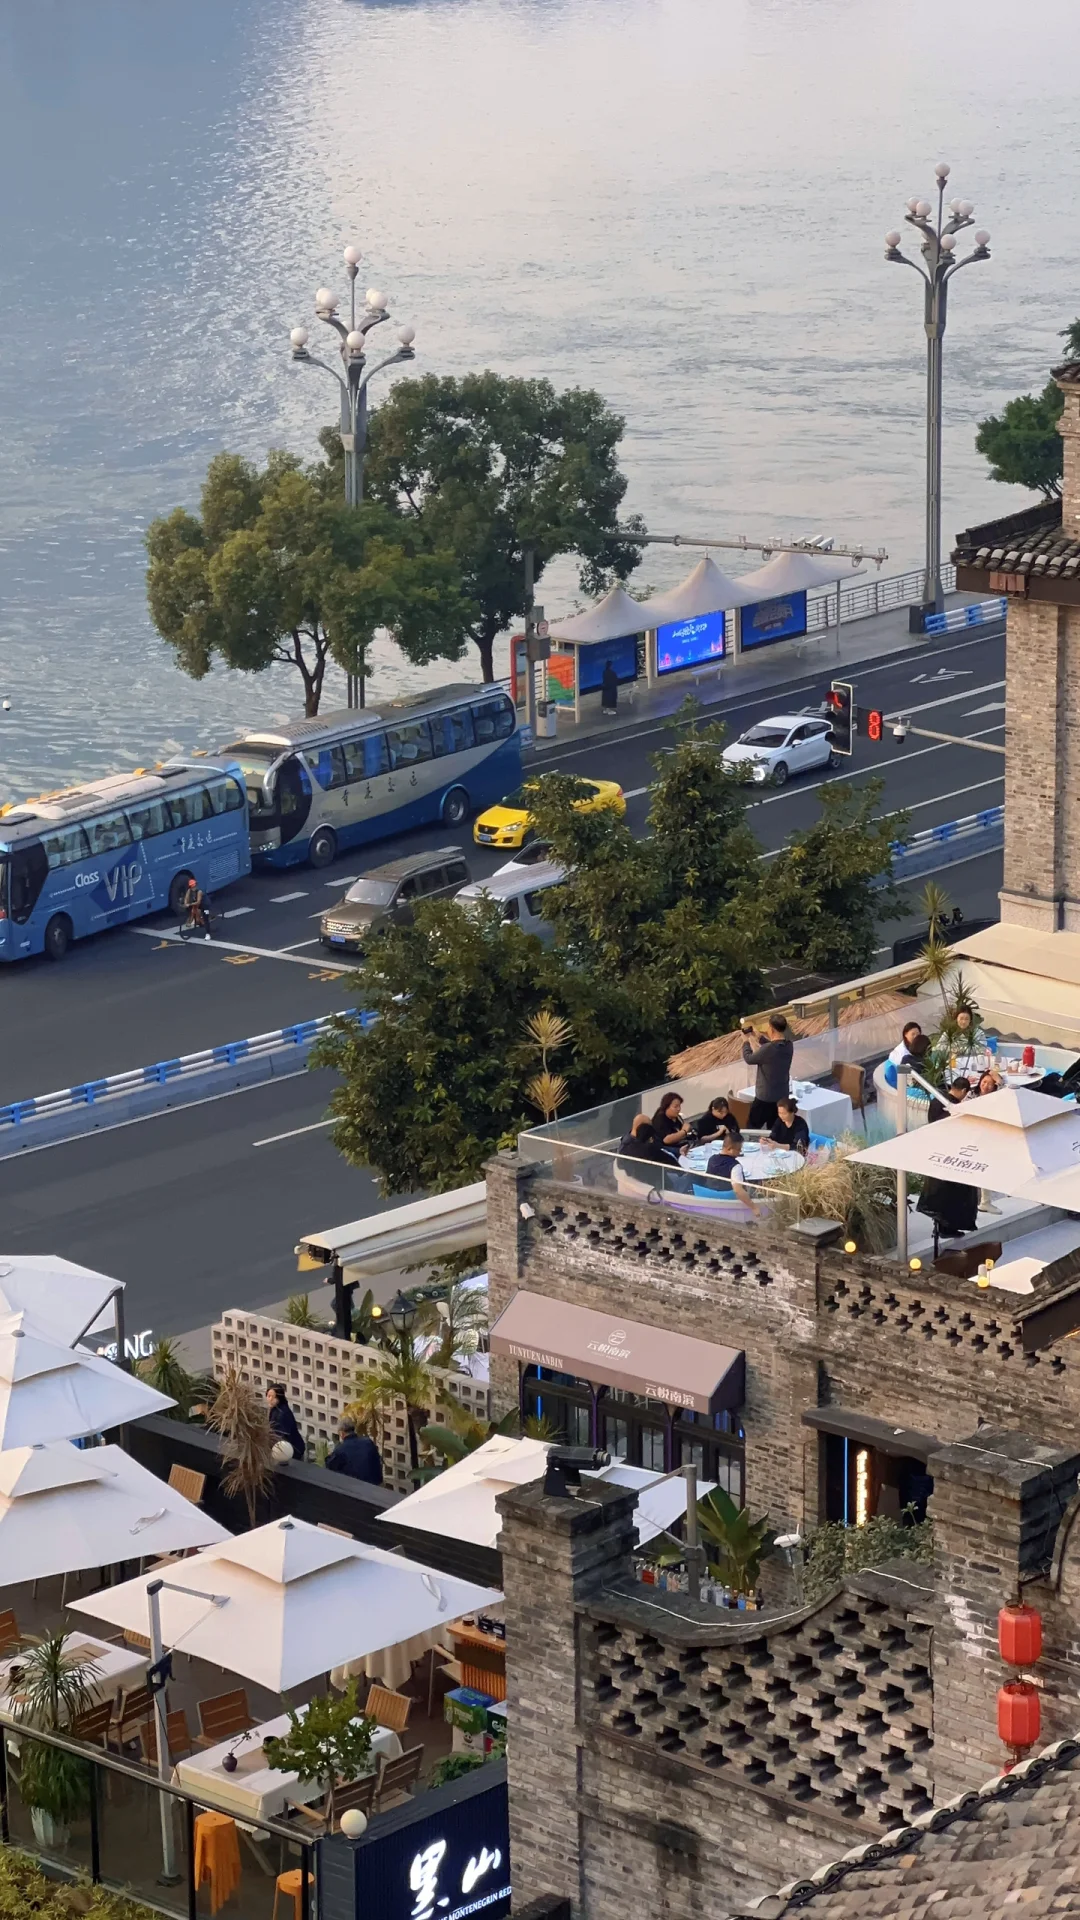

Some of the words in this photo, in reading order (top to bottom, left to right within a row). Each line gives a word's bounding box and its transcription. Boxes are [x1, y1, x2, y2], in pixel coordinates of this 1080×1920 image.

[75, 871, 99, 888] Class
[103, 861, 142, 902] VIP
[509, 1344, 563, 1369] YUNYUENANBIN
[645, 1383, 694, 1407] 云悦南滨
[448, 1891, 498, 1920] MONTENEGRIN
